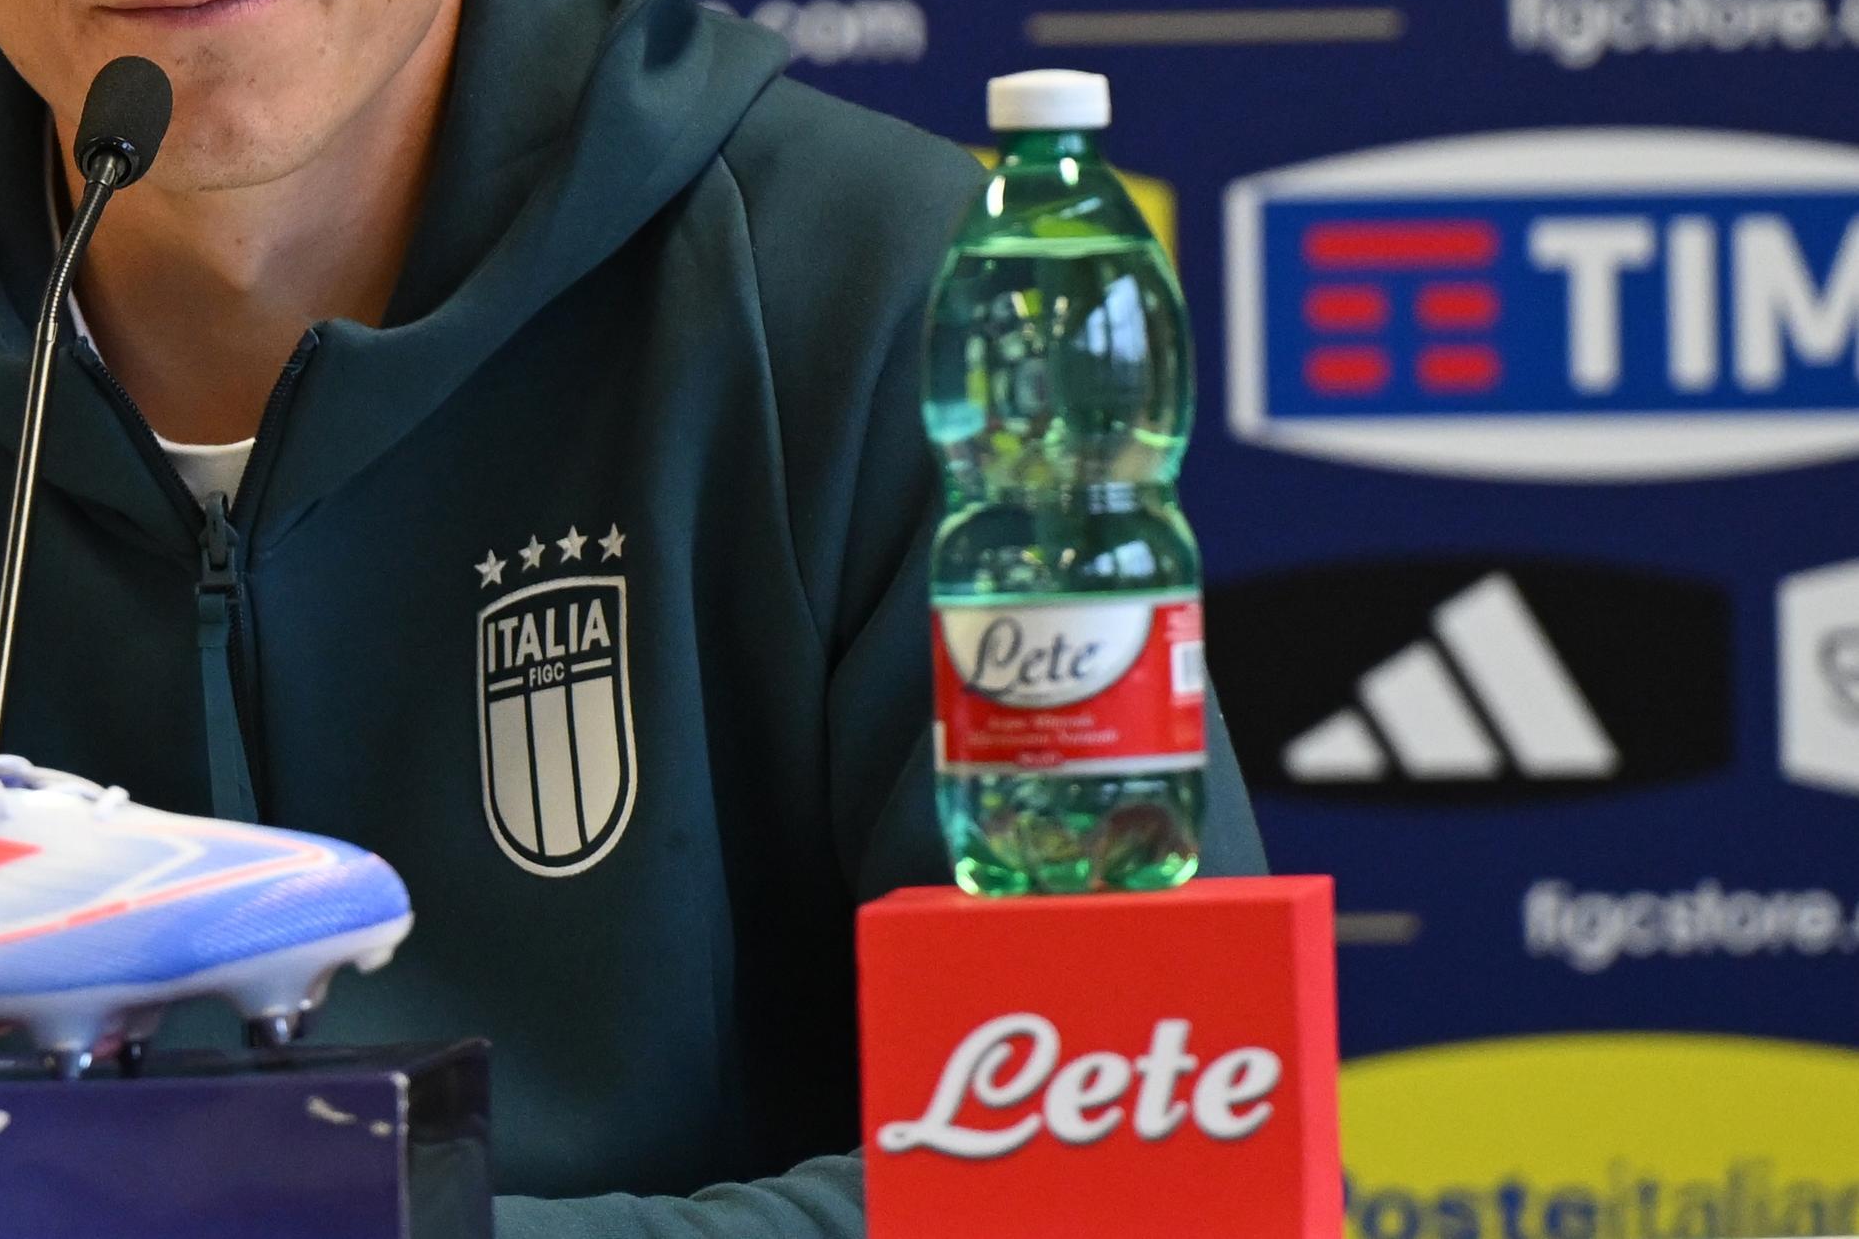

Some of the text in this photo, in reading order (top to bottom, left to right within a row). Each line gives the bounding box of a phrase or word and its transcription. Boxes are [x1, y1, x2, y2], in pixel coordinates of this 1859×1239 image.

[1528, 214, 1859, 393] TIM
[487, 597, 611, 674] ITALIA
[528, 660, 567, 688] FIGC
[961, 615, 1103, 701] Lete
[876, 1012, 1283, 1160] Lete
